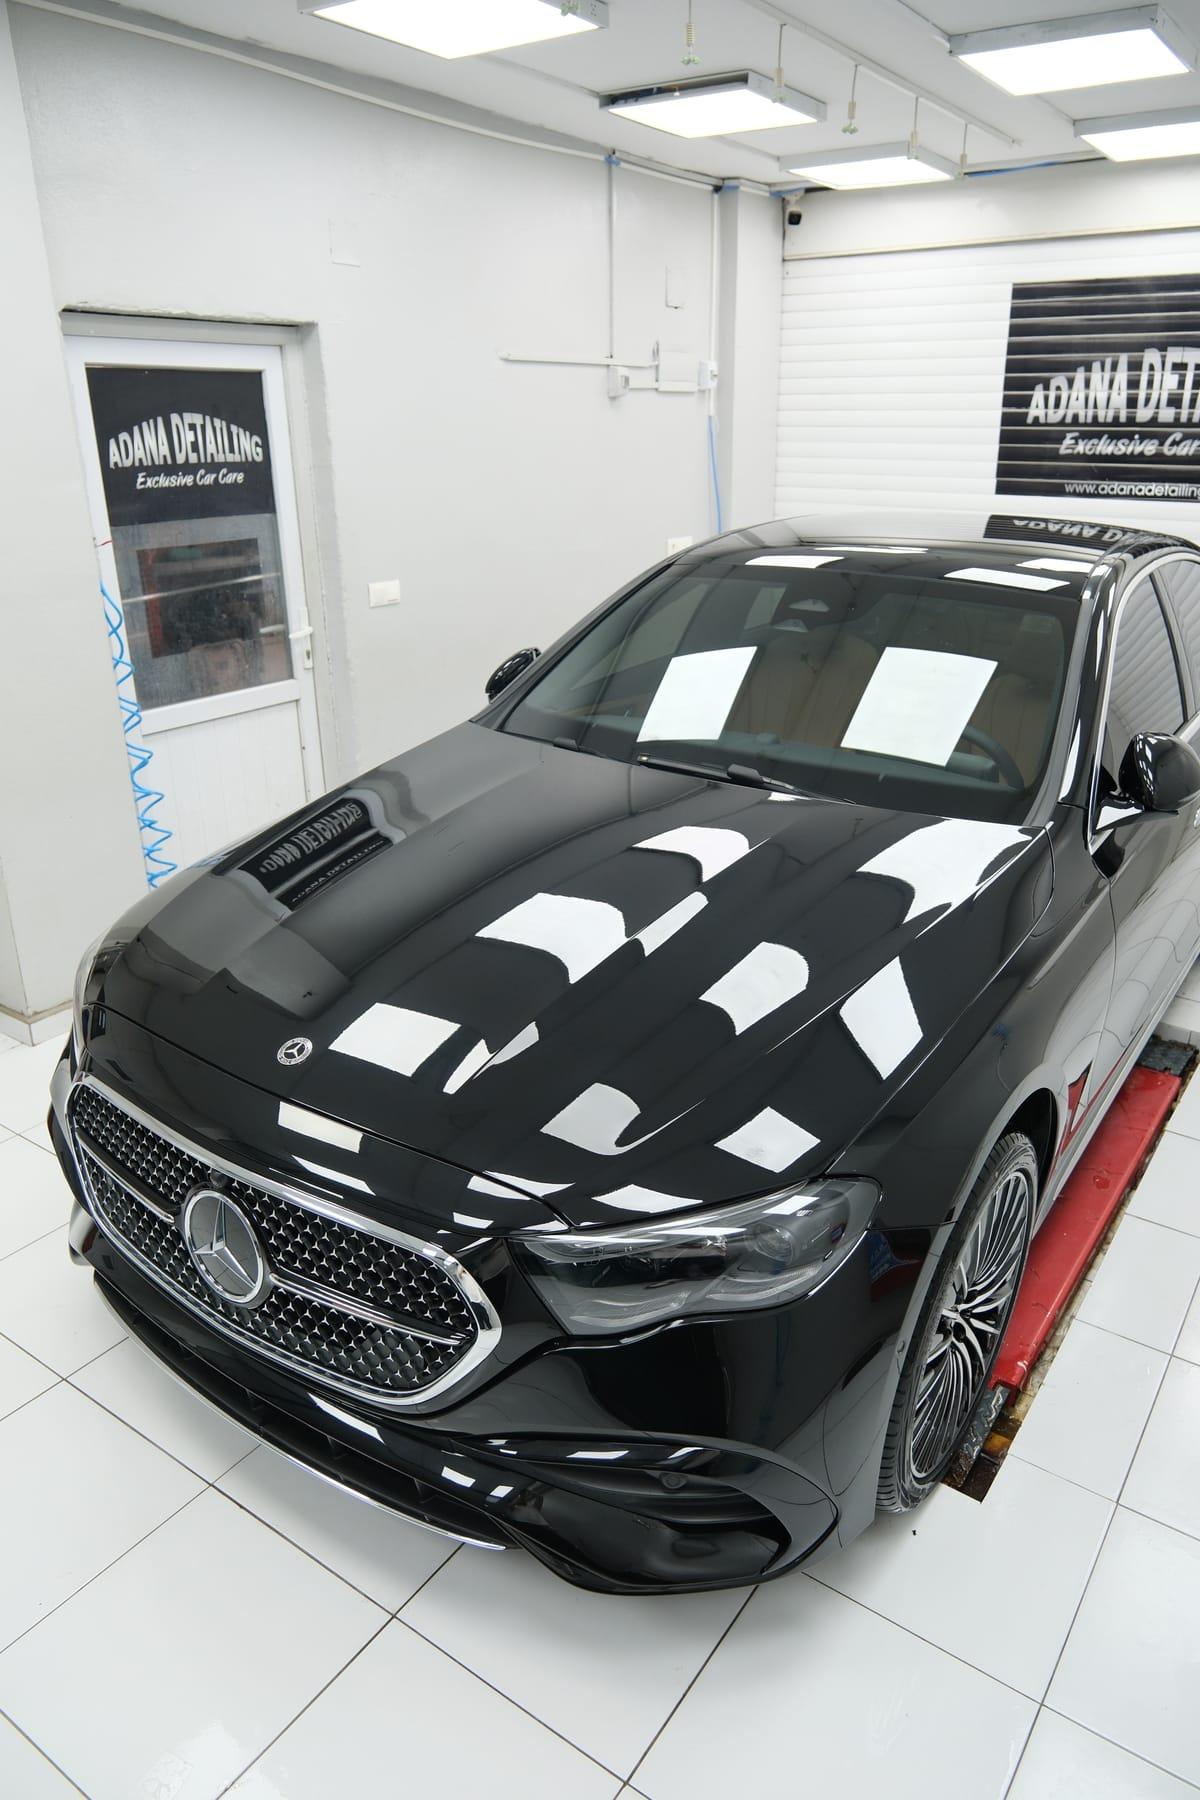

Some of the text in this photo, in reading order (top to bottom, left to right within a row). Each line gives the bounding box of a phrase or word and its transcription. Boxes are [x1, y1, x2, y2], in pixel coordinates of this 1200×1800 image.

[1026, 346, 1200, 424] ADANA DET
[108, 412, 264, 469] ADANA DETAILING
[1059, 432, 1158, 456] Exclusive
[135, 467, 245, 490] Exclusive Car Care
